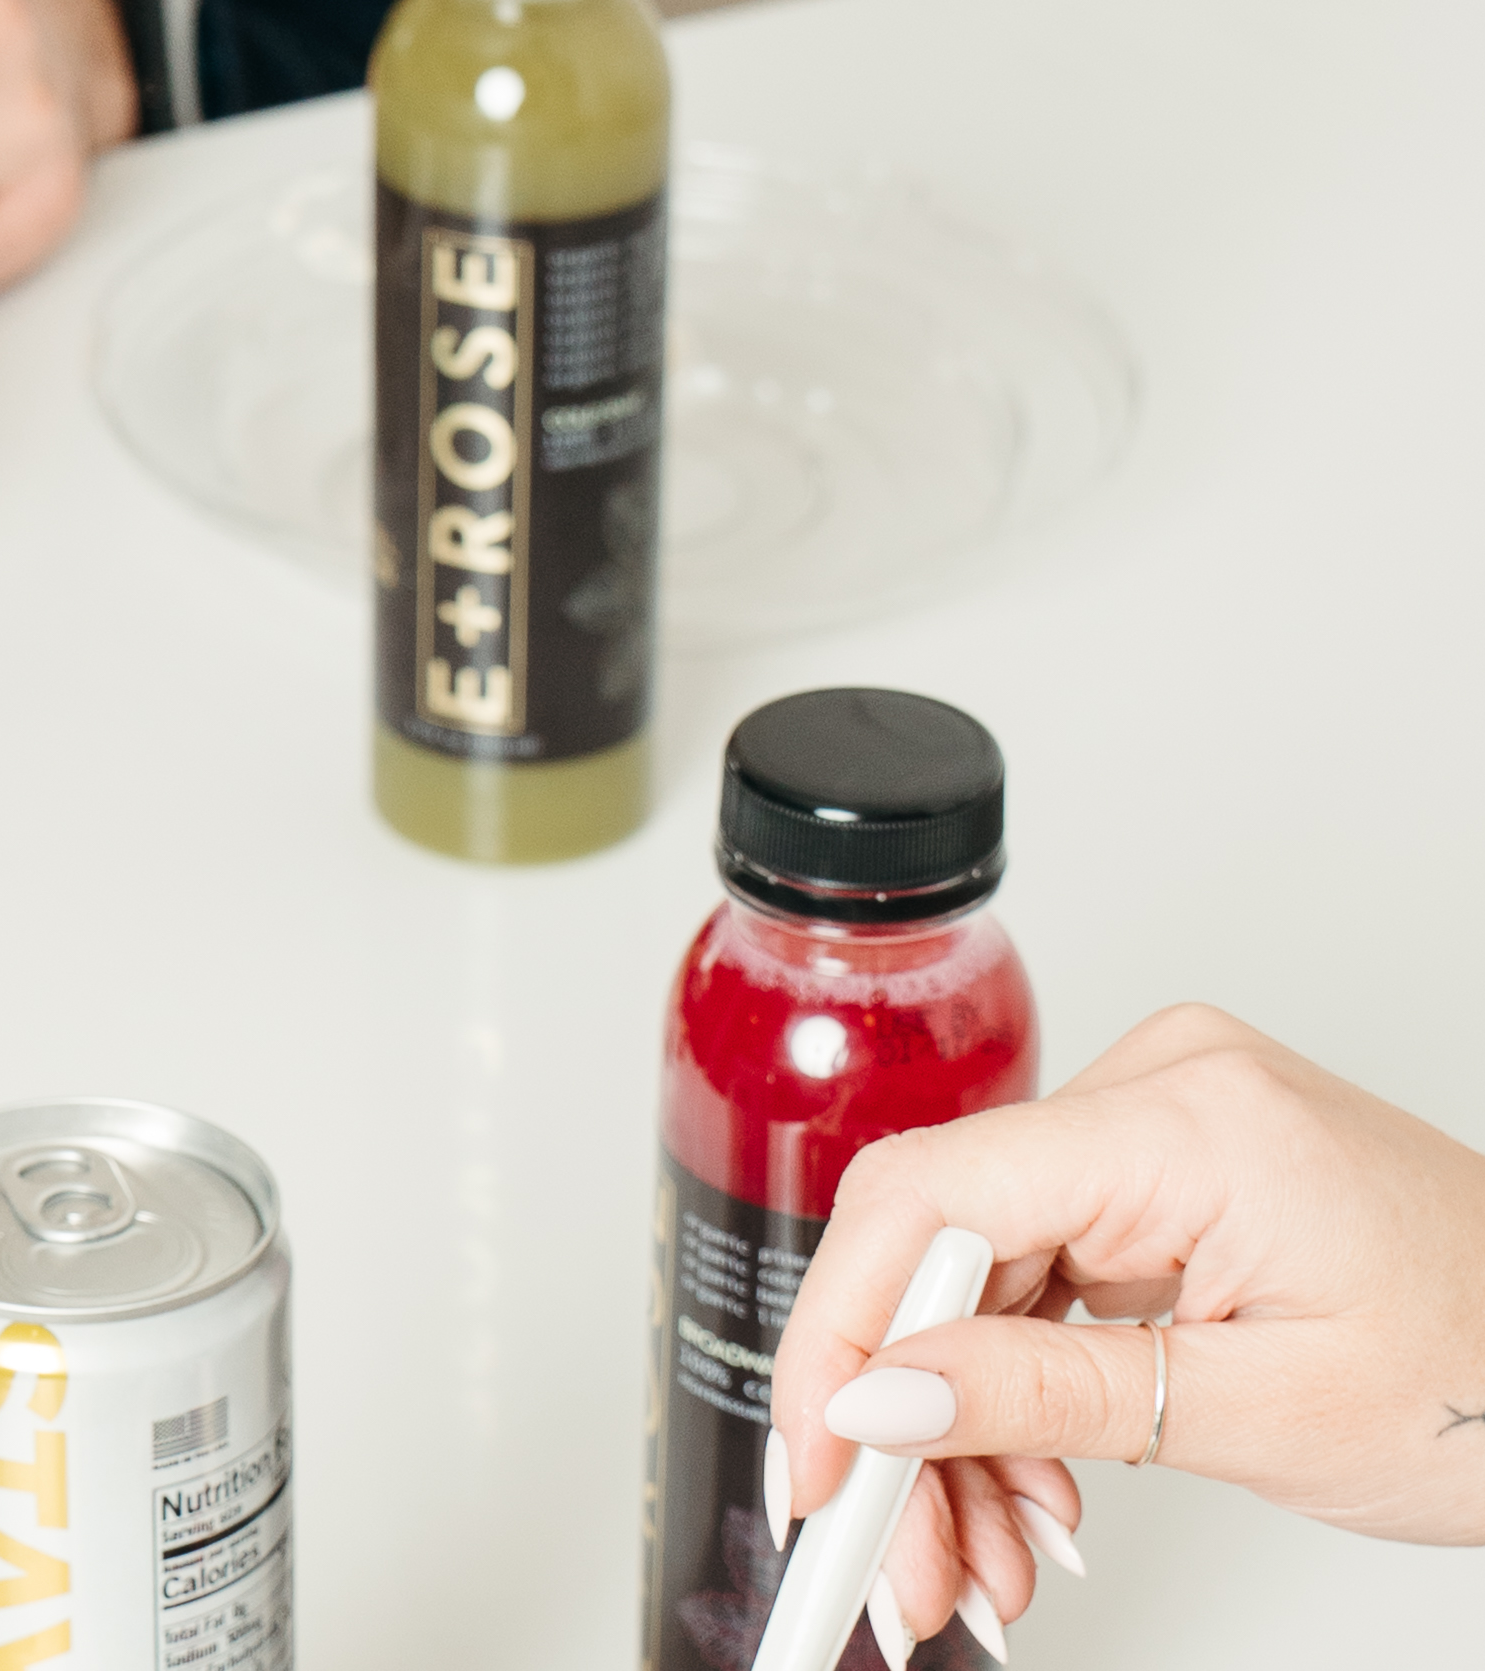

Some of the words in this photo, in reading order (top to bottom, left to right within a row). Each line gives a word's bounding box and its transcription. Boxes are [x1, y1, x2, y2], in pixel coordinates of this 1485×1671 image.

[425, 242, 518, 725] E+ROSE
[162, 1452, 272, 1521] Nutrition
[163, 1545, 258, 1599] Calories
